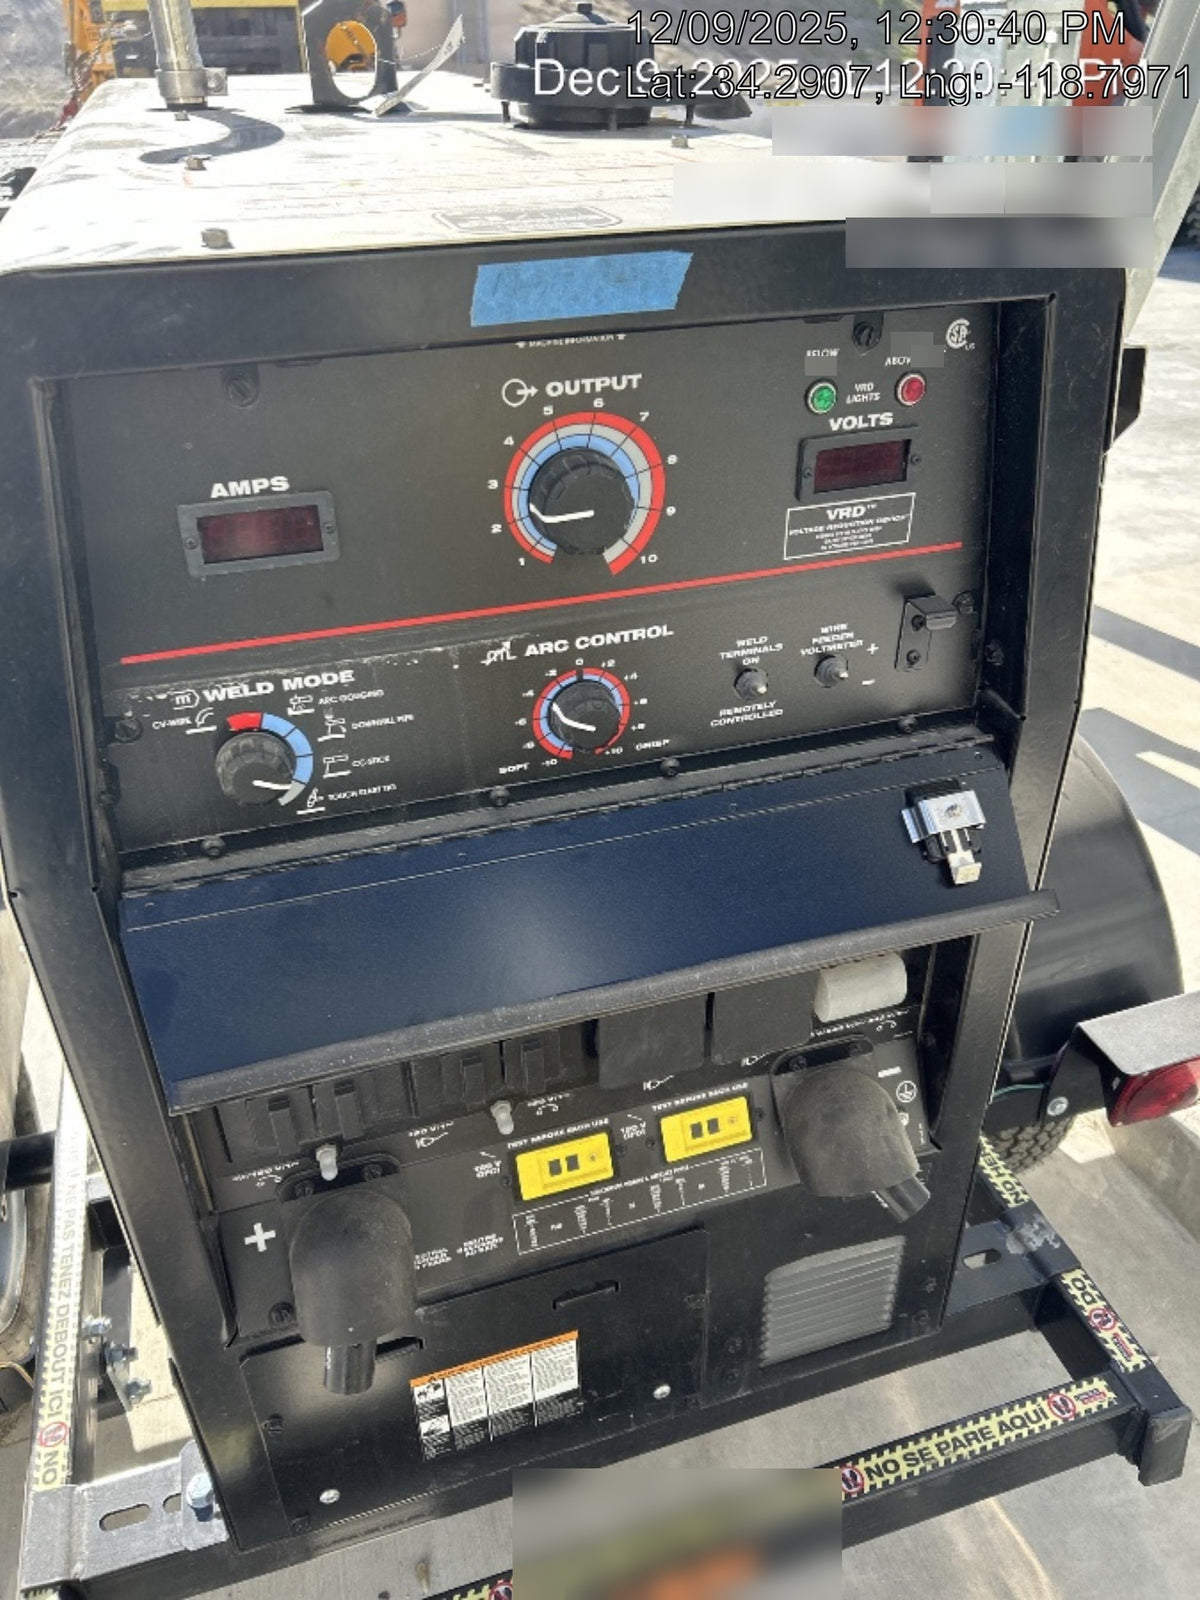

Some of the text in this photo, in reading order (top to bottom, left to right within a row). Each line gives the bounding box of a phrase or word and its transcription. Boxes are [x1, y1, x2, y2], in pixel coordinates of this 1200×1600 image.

[884, 356, 911, 367] ABOV
[545, 374, 642, 397] OUTPUT
[593, 398, 604, 408] 6
[846, 392, 881, 404] LIGHTS
[543, 405, 554, 416] 5
[639, 411, 650, 422] 7
[829, 412, 894, 431] VOLTS
[504, 436, 515, 446] 4
[667, 455, 678, 465] 8
[210, 476, 290, 498] AMPS
[487, 479, 499, 490] 3
[666, 506, 677, 517] 9
[491, 524, 502, 534] 2
[519, 557, 526, 567] 1
[641, 554, 659, 564] 10
[524, 624, 674, 656] ARC CONTROL
[736, 636, 768, 648] WELD
[720, 643, 783, 660] TERMINALS
[742, 656, 760, 665] ON
[203, 670, 355, 702] WELD MODE
[57, 1241, 76, 1302] TENEZ
[50, 1303, 70, 1383] DEBOUT
[48, 1390, 64, 1418] ICI
[863, 1458, 899, 1482] NO
[902, 1444, 932, 1468] SE
[934, 1429, 995, 1457] PARE
[41, 1450, 60, 1486] NO
